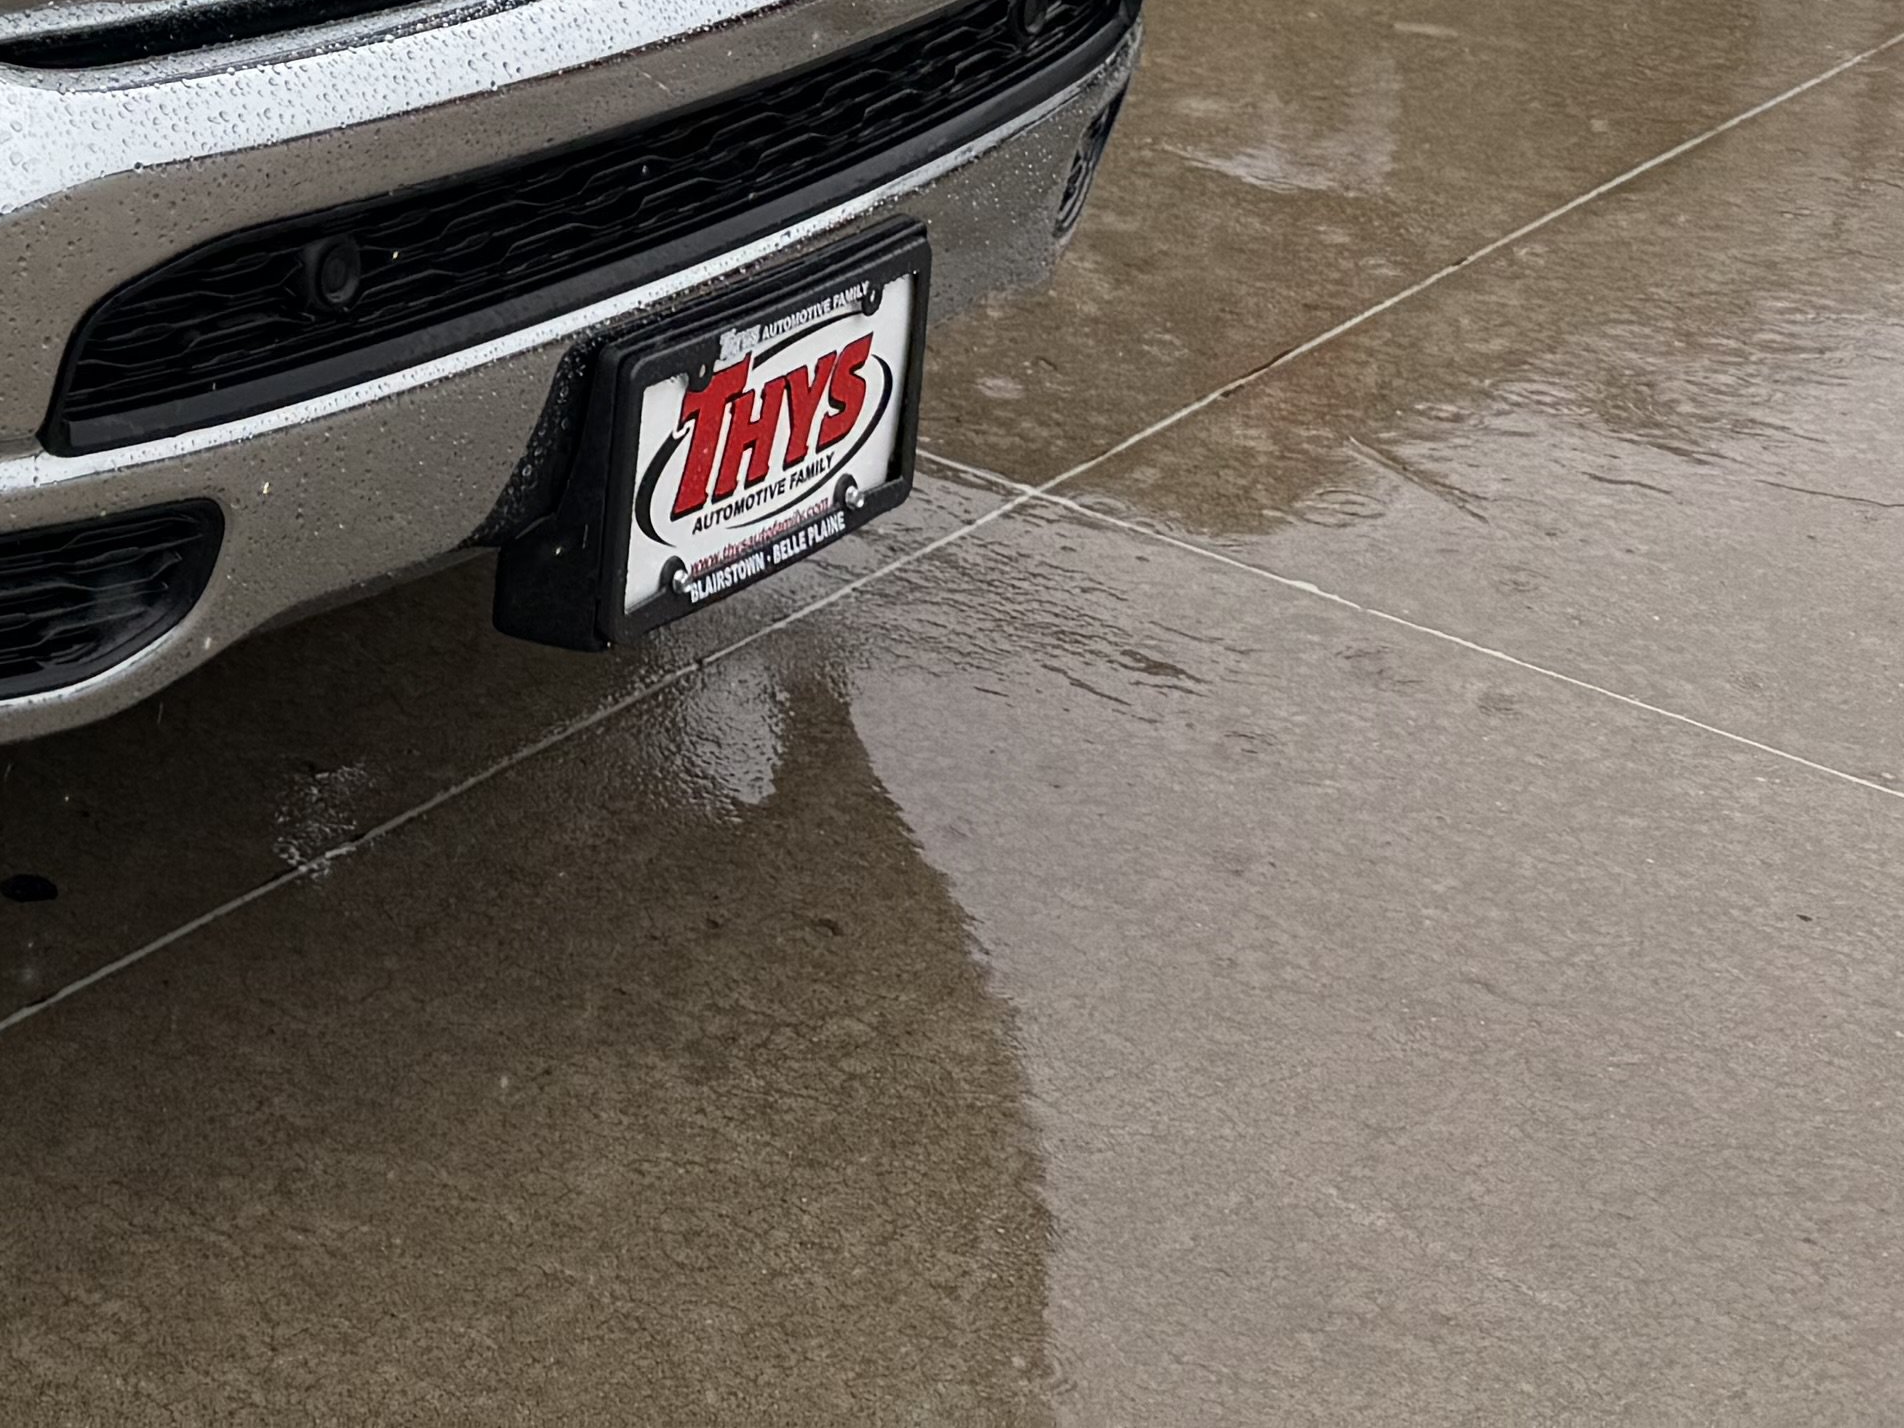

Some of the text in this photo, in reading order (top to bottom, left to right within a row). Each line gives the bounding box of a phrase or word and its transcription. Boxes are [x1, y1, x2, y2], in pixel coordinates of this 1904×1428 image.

[762, 298, 831, 340] AUTOMOTIVE
[833, 280, 869, 308] FAMILY
[671, 332, 873, 521] THYS
[692, 452, 834, 534] AUTOMOTIVE FAMILY
[690, 511, 846, 603] BLAIRSTOWN BELLE PLAINE
